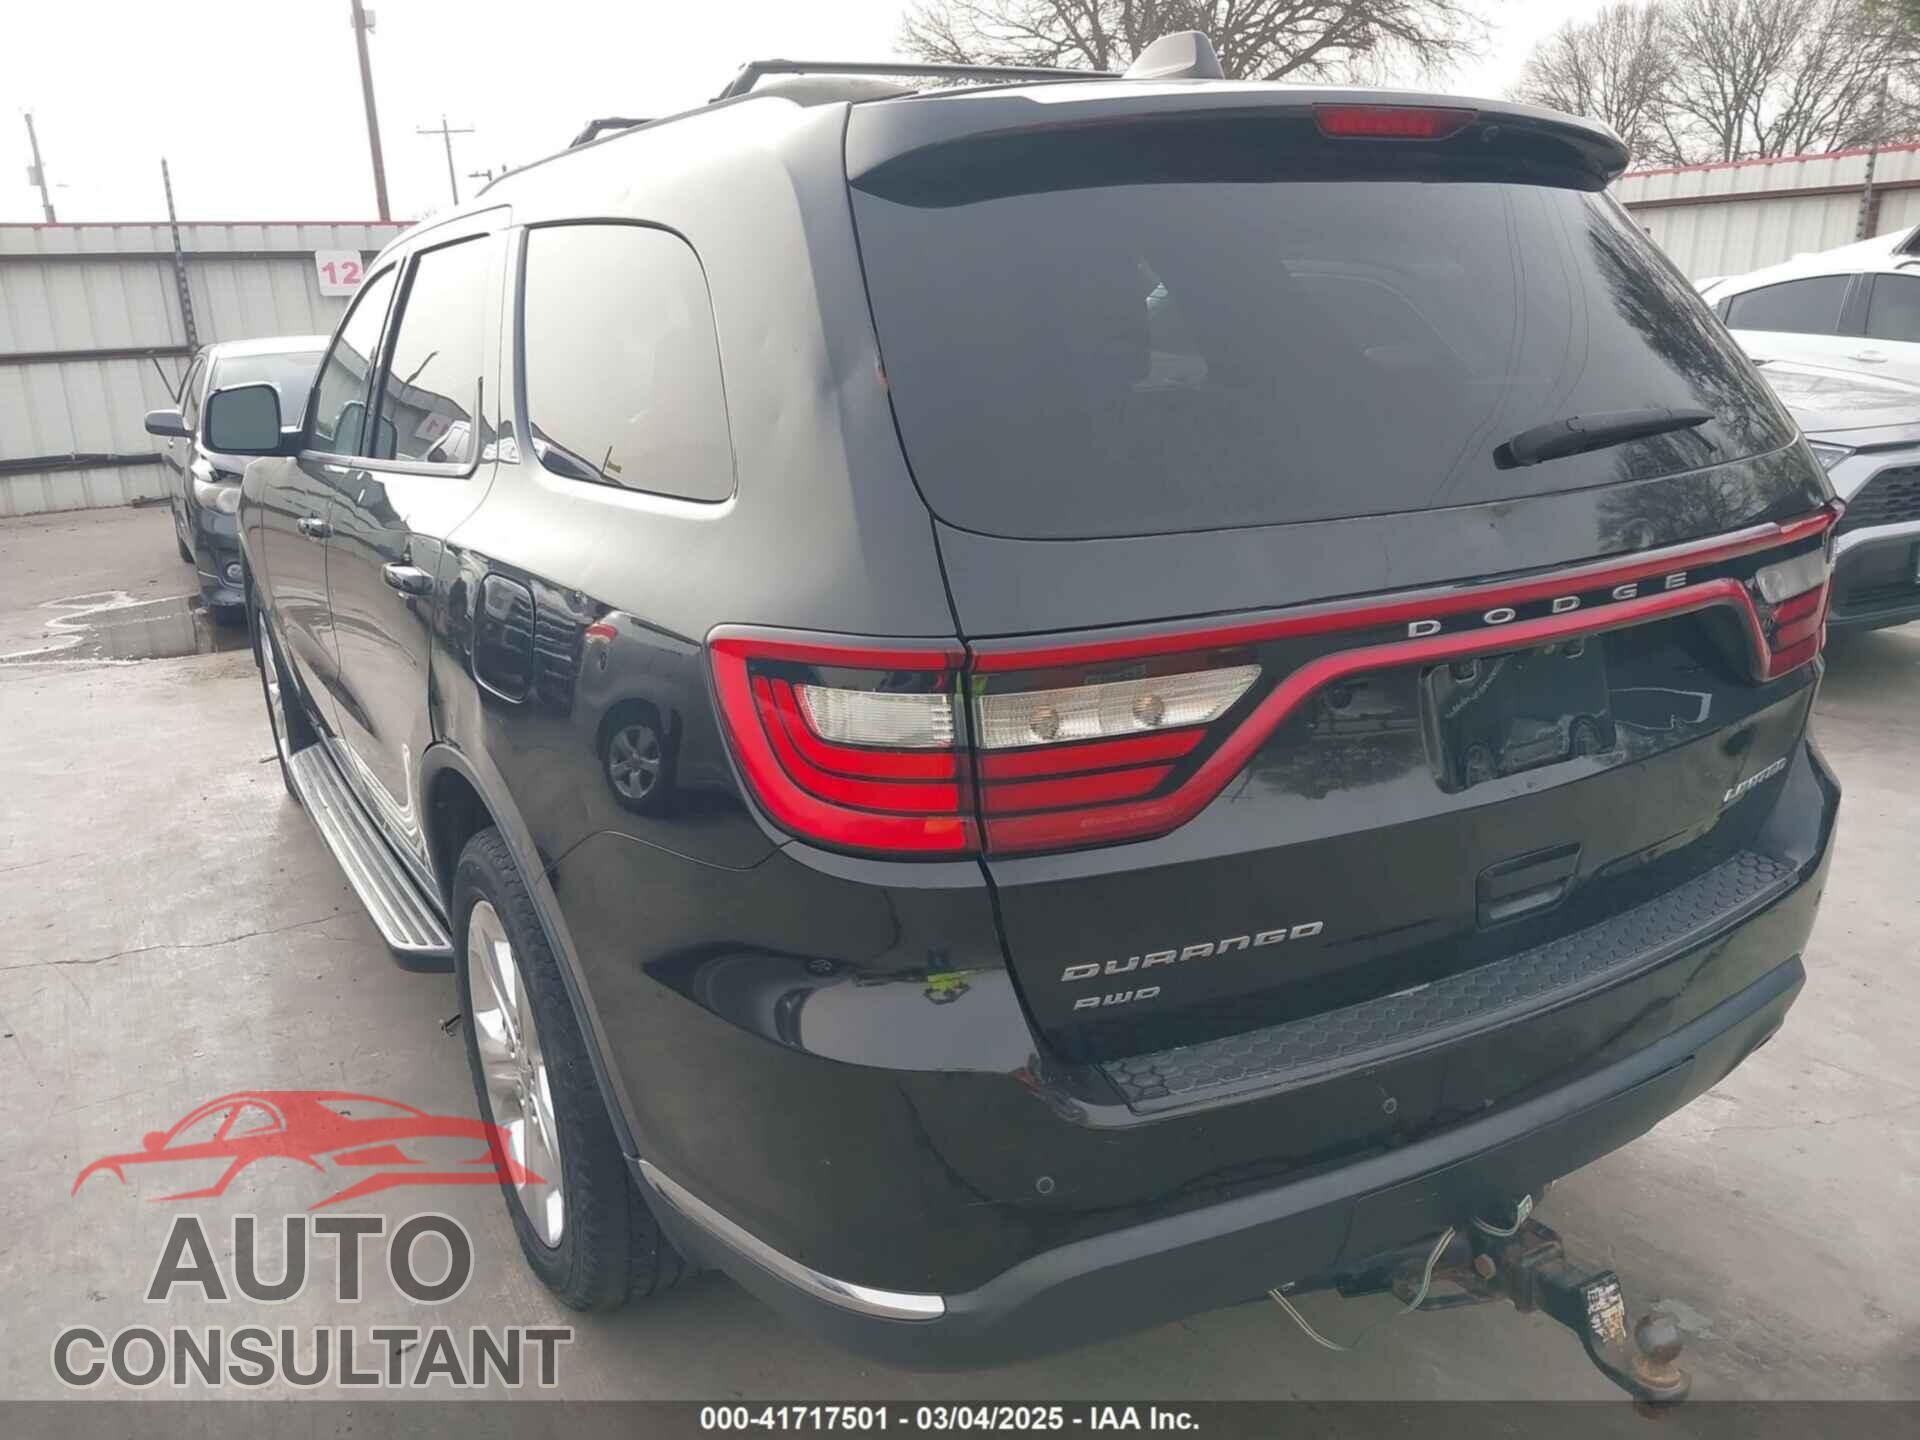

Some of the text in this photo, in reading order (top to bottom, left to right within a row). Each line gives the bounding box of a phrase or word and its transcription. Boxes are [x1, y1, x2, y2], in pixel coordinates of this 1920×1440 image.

[322, 261, 361, 285] 12
[1407, 571, 1687, 638] DODGE
[1061, 920, 1324, 982] DURANGO
[1073, 986, 1161, 1011] AWD
